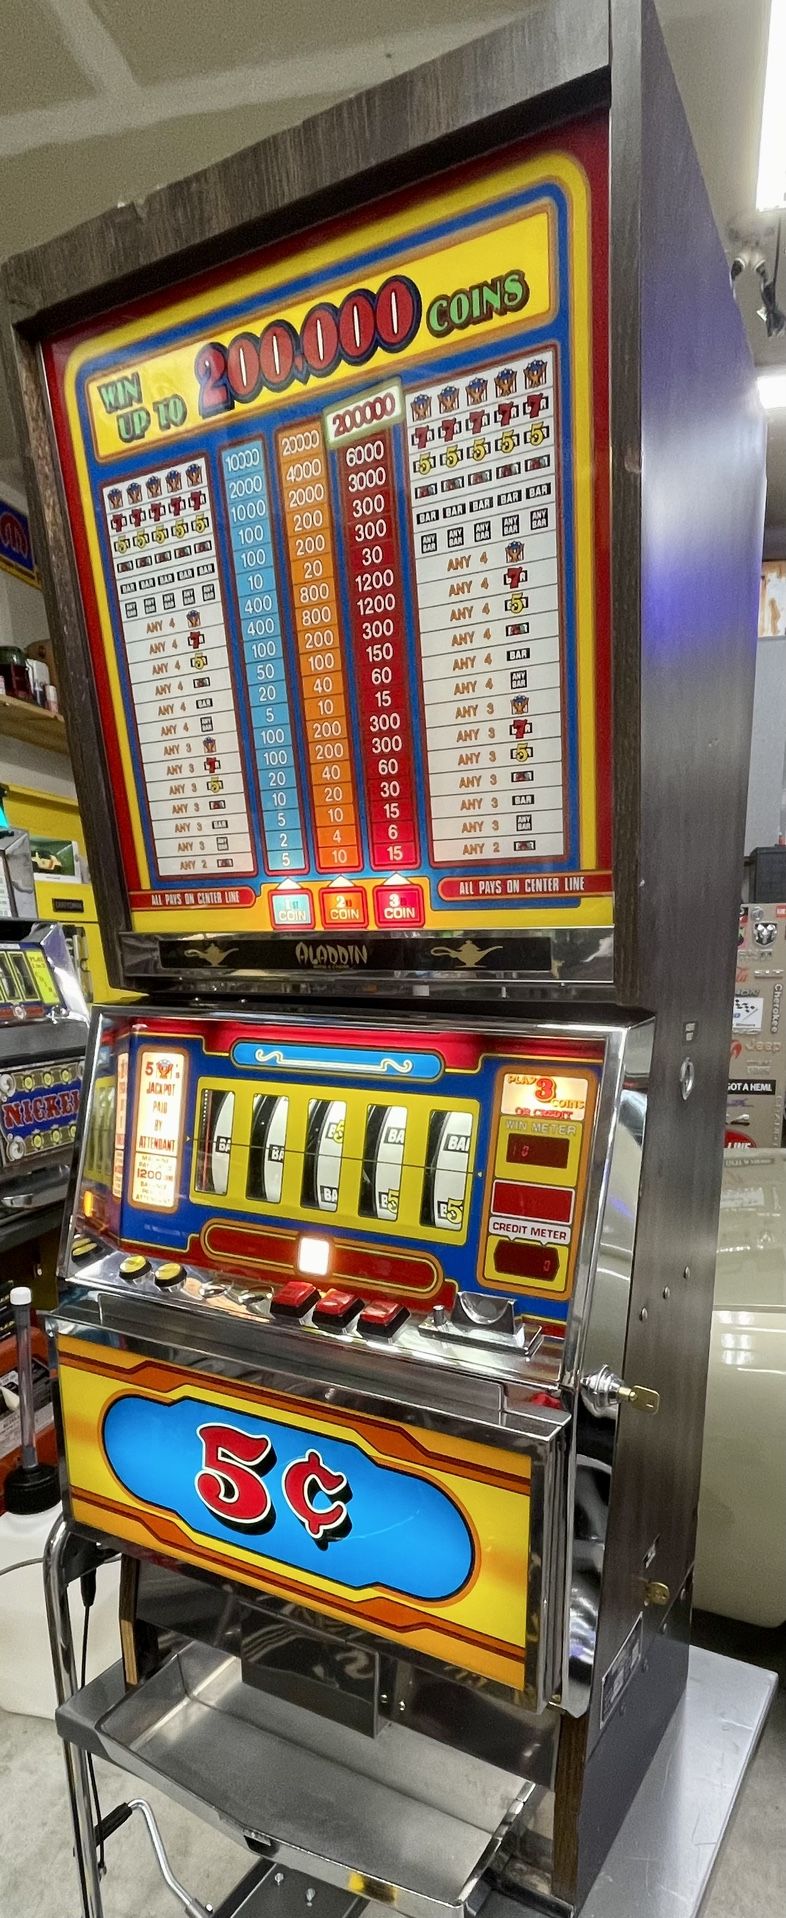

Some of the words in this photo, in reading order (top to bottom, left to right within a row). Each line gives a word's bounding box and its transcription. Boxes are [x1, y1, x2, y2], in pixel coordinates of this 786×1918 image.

[426, 269, 529, 338] COINS
[97, 372, 143, 414] WIN
[116, 408, 150, 443] UP
[153, 393, 187, 431] TO
[332, 393, 396, 437] 200000
[282, 430, 320, 456] 20000
[224, 448, 260, 472] 10000
[346, 440, 384, 466] 6000
[286, 459, 321, 482] 4000
[348, 466, 386, 492] 3000
[229, 477, 263, 499] 2000
[289, 484, 324, 507] 2000
[231, 501, 266, 522] 1000
[352, 494, 385, 518] 300
[420, 511, 436, 523] BAR
[446, 505, 463, 517] BAR
[473, 499, 490, 511] BAR
[501, 492, 518, 504] BAR
[529, 485, 547, 497] BAR
[294, 510, 323, 531] 200
[238, 525, 264, 544] 100
[355, 519, 387, 542] 300
[296, 534, 325, 556] 200
[241, 549, 266, 567] 100
[362, 546, 383, 566] 30
[447, 555, 471, 571] ANY
[480, 552, 488, 564] 4
[304, 560, 323, 578] 20
[248, 573, 263, 589] 10
[355, 569, 394, 592] 1200
[449, 581, 472, 597] ANY
[481, 578, 489, 589] 4
[300, 583, 329, 603] 800
[245, 595, 272, 614] 400
[357, 593, 396, 616] 1200
[450, 606, 473, 622] ANY
[482, 603, 490, 615] 4
[302, 606, 331, 625] 800
[247, 618, 274, 636] 400
[362, 619, 394, 640] 300
[172, 639, 178, 649] 4
[305, 630, 333, 648] 200
[452, 632, 474, 646] ANY
[483, 629, 491, 640] 4
[252, 641, 276, 659] 100
[366, 643, 393, 662] 150
[308, 653, 334, 670] 100
[453, 656, 476, 671] ANY
[484, 654, 492, 665] 4
[510, 650, 527, 660] BAR
[257, 664, 275, 680] 50
[372, 666, 392, 685] 60
[512, 672, 525, 680] ANY
[177, 682, 184, 691] 4
[313, 677, 332, 693] 40
[454, 681, 477, 695] ANY
[485, 678, 493, 690] 4
[512, 679, 525, 688] BAR
[259, 685, 276, 701] 20
[375, 690, 391, 707] 15
[266, 708, 274, 722] 5
[318, 699, 333, 715] 10
[456, 705, 478, 719] ANY
[487, 703, 494, 715] 3
[312, 720, 341, 738] 200
[370, 713, 400, 732] 300
[261, 729, 285, 745] 100
[457, 729, 479, 742] ANY
[488, 727, 496, 738] 3
[186, 743, 192, 752] 3
[315, 743, 343, 760] 200
[372, 735, 402, 753] 300
[264, 750, 287, 767] 100
[378, 758, 398, 775] 60
[458, 752, 480, 766] ANY
[489, 751, 497, 762] 3
[268, 772, 286, 786] 20
[322, 765, 341, 780] 40
[380, 781, 400, 797] 30
[459, 776, 481, 788] ANY
[490, 775, 497, 785] 3
[273, 793, 287, 806] 10
[324, 787, 343, 802] 20
[384, 803, 400, 818] 15
[460, 799, 482, 811] ANY
[491, 798, 498, 808] 3
[277, 813, 286, 826] 5
[328, 808, 343, 822] 10
[388, 825, 398, 839] 6
[461, 821, 484, 833] ANY
[492, 820, 500, 831] 3
[280, 834, 288, 847] 2
[333, 830, 341, 842] 4
[332, 850, 347, 863] 10
[387, 845, 403, 860] 15
[463, 843, 485, 855] ANY
[493, 842, 500, 852] 2
[282, 854, 290, 866] 5
[459, 882, 473, 895] ALL
[479, 881, 502, 894] PAYS
[507, 880, 519, 893] ON
[525, 878, 559, 892] CENTER
[565, 877, 585, 891] LINE
[152, 895, 162, 906] ALL
[165, 894, 182, 905] PAYS
[185, 893, 195, 904] ON
[198, 892, 222, 904] CENTER
[226, 891, 240, 903] LINE
[279, 910, 306, 921] COIN
[330, 909, 359, 919] COIN
[384, 907, 415, 919] COIN
[295, 942, 368, 964] ALADDIN
[771, 983, 783, 1033] Cherokee
[744, 1039, 781, 1053] Jeep
[145, 1062, 154, 1076] 5
[146, 1082, 175, 1096] JACKPOT
[507, 1075, 537, 1085] PLAY
[535, 1076, 557, 1103] 3
[551, 1099, 585, 1109] COINS
[153, 1100, 167, 1114] PAID
[515, 1107, 531, 1116] OR
[533, 1109, 573, 1120] CREDIT
[154, 1120, 163, 1131] BY
[505, 1120, 527, 1130] WIN
[532, 1122, 576, 1136] METER
[139, 1135, 175, 1152] ATTENDANT
[137, 1168, 162, 1181] 1200
[492, 1222, 527, 1235] CREDIT
[530, 1227, 567, 1240] METER
